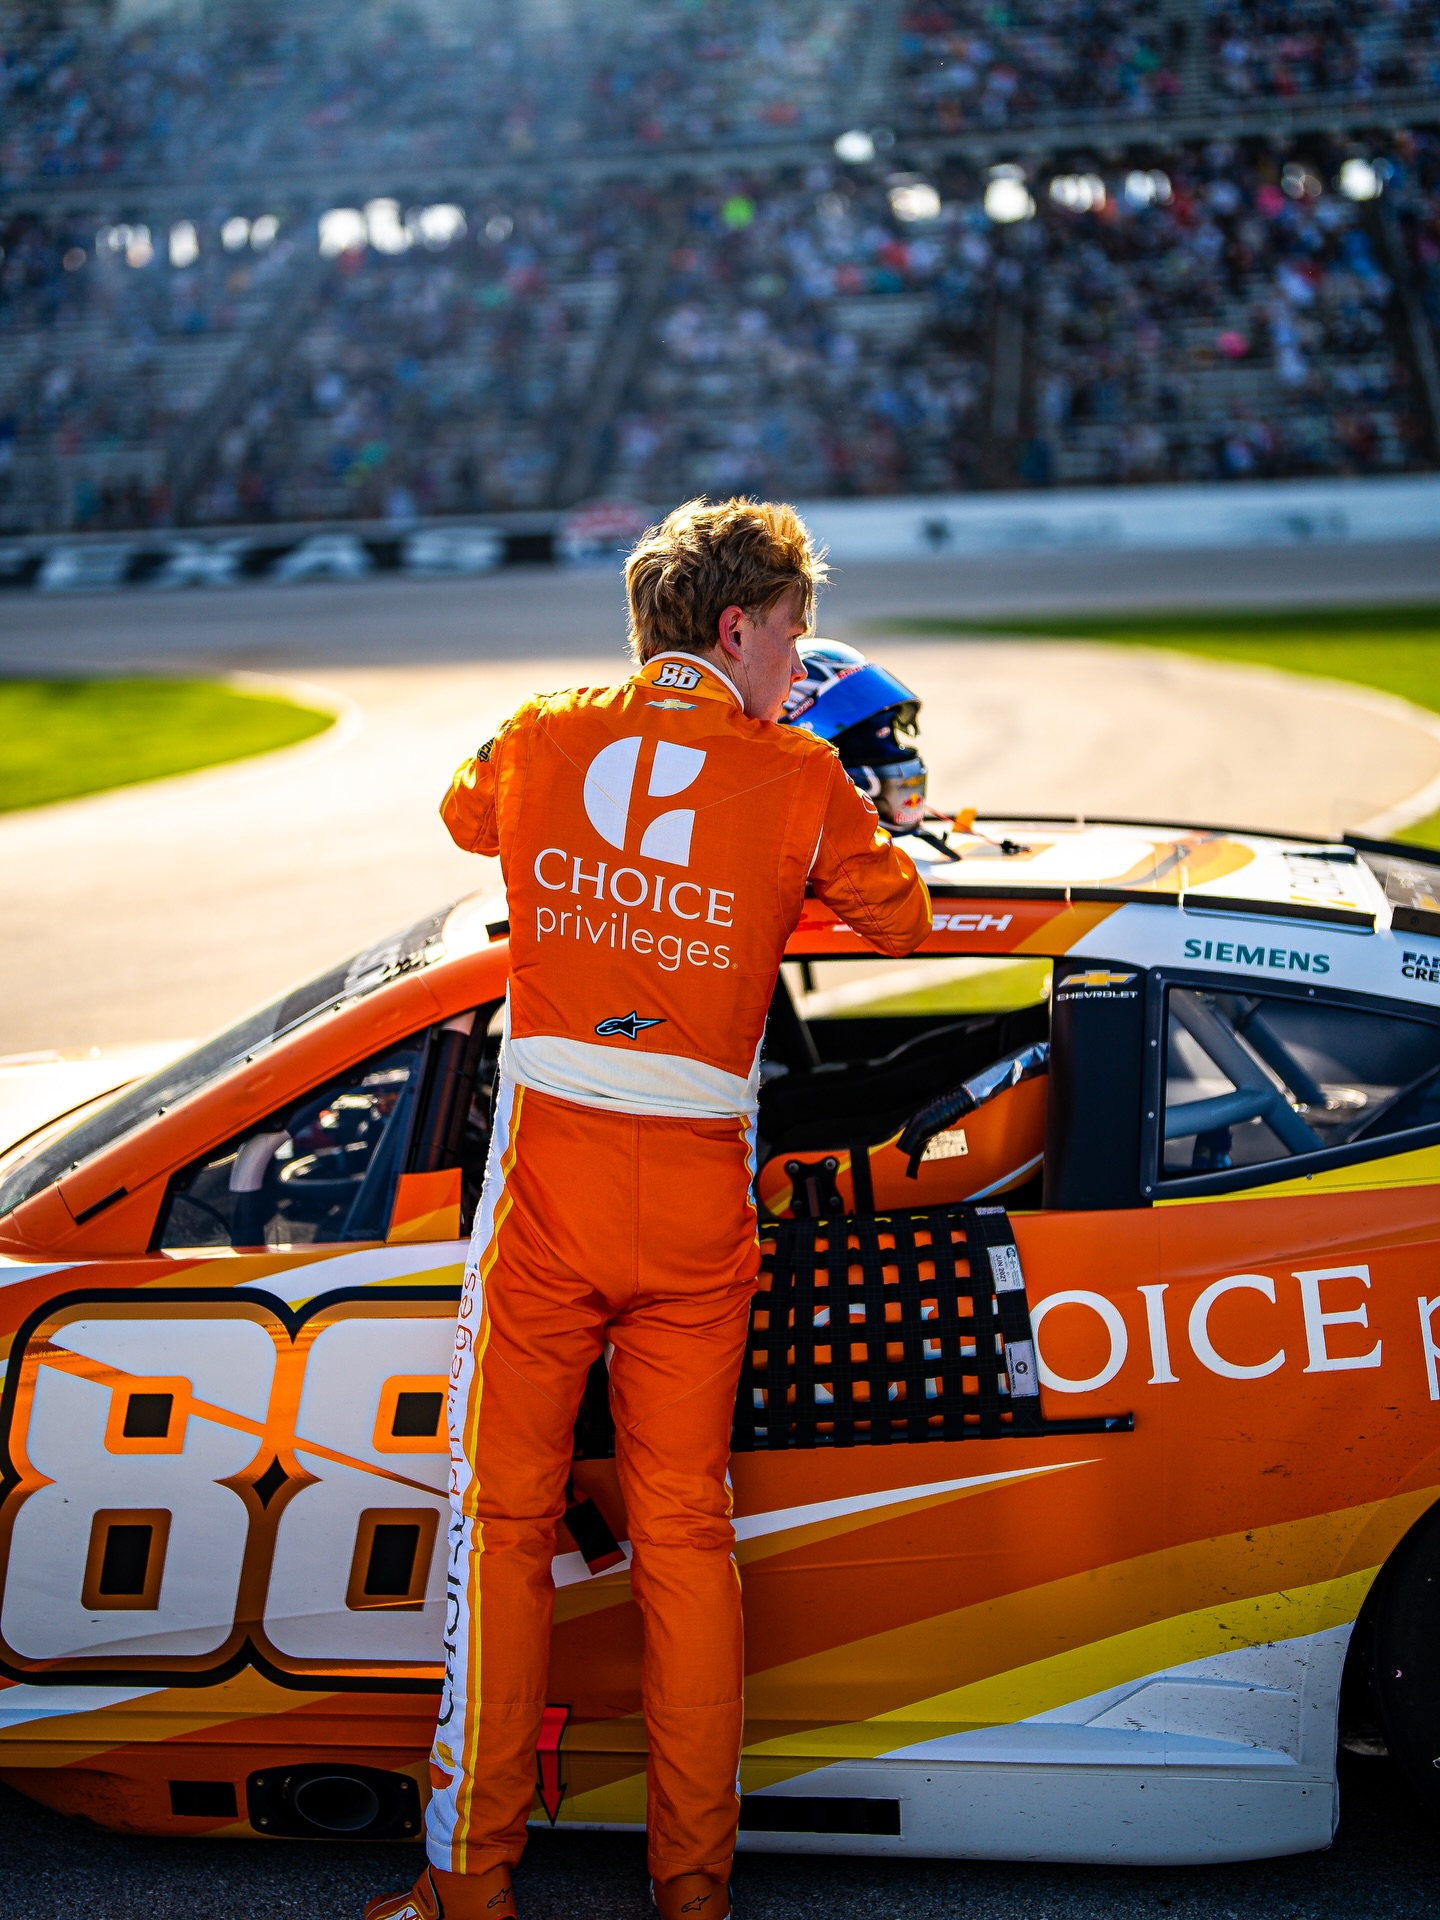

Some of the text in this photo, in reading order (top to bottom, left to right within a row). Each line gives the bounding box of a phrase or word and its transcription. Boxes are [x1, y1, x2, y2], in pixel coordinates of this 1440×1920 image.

[0, 528, 502, 592] EXAS
[534, 848, 735, 928] CHOICE
[1184, 938, 1331, 975] SIEMENS
[1056, 990, 1138, 1001] CHEVROLET
[996, 1254, 1004, 1267] JUN
[999, 1268, 1007, 1282] 2027
[0, 1310, 450, 1664] 88
